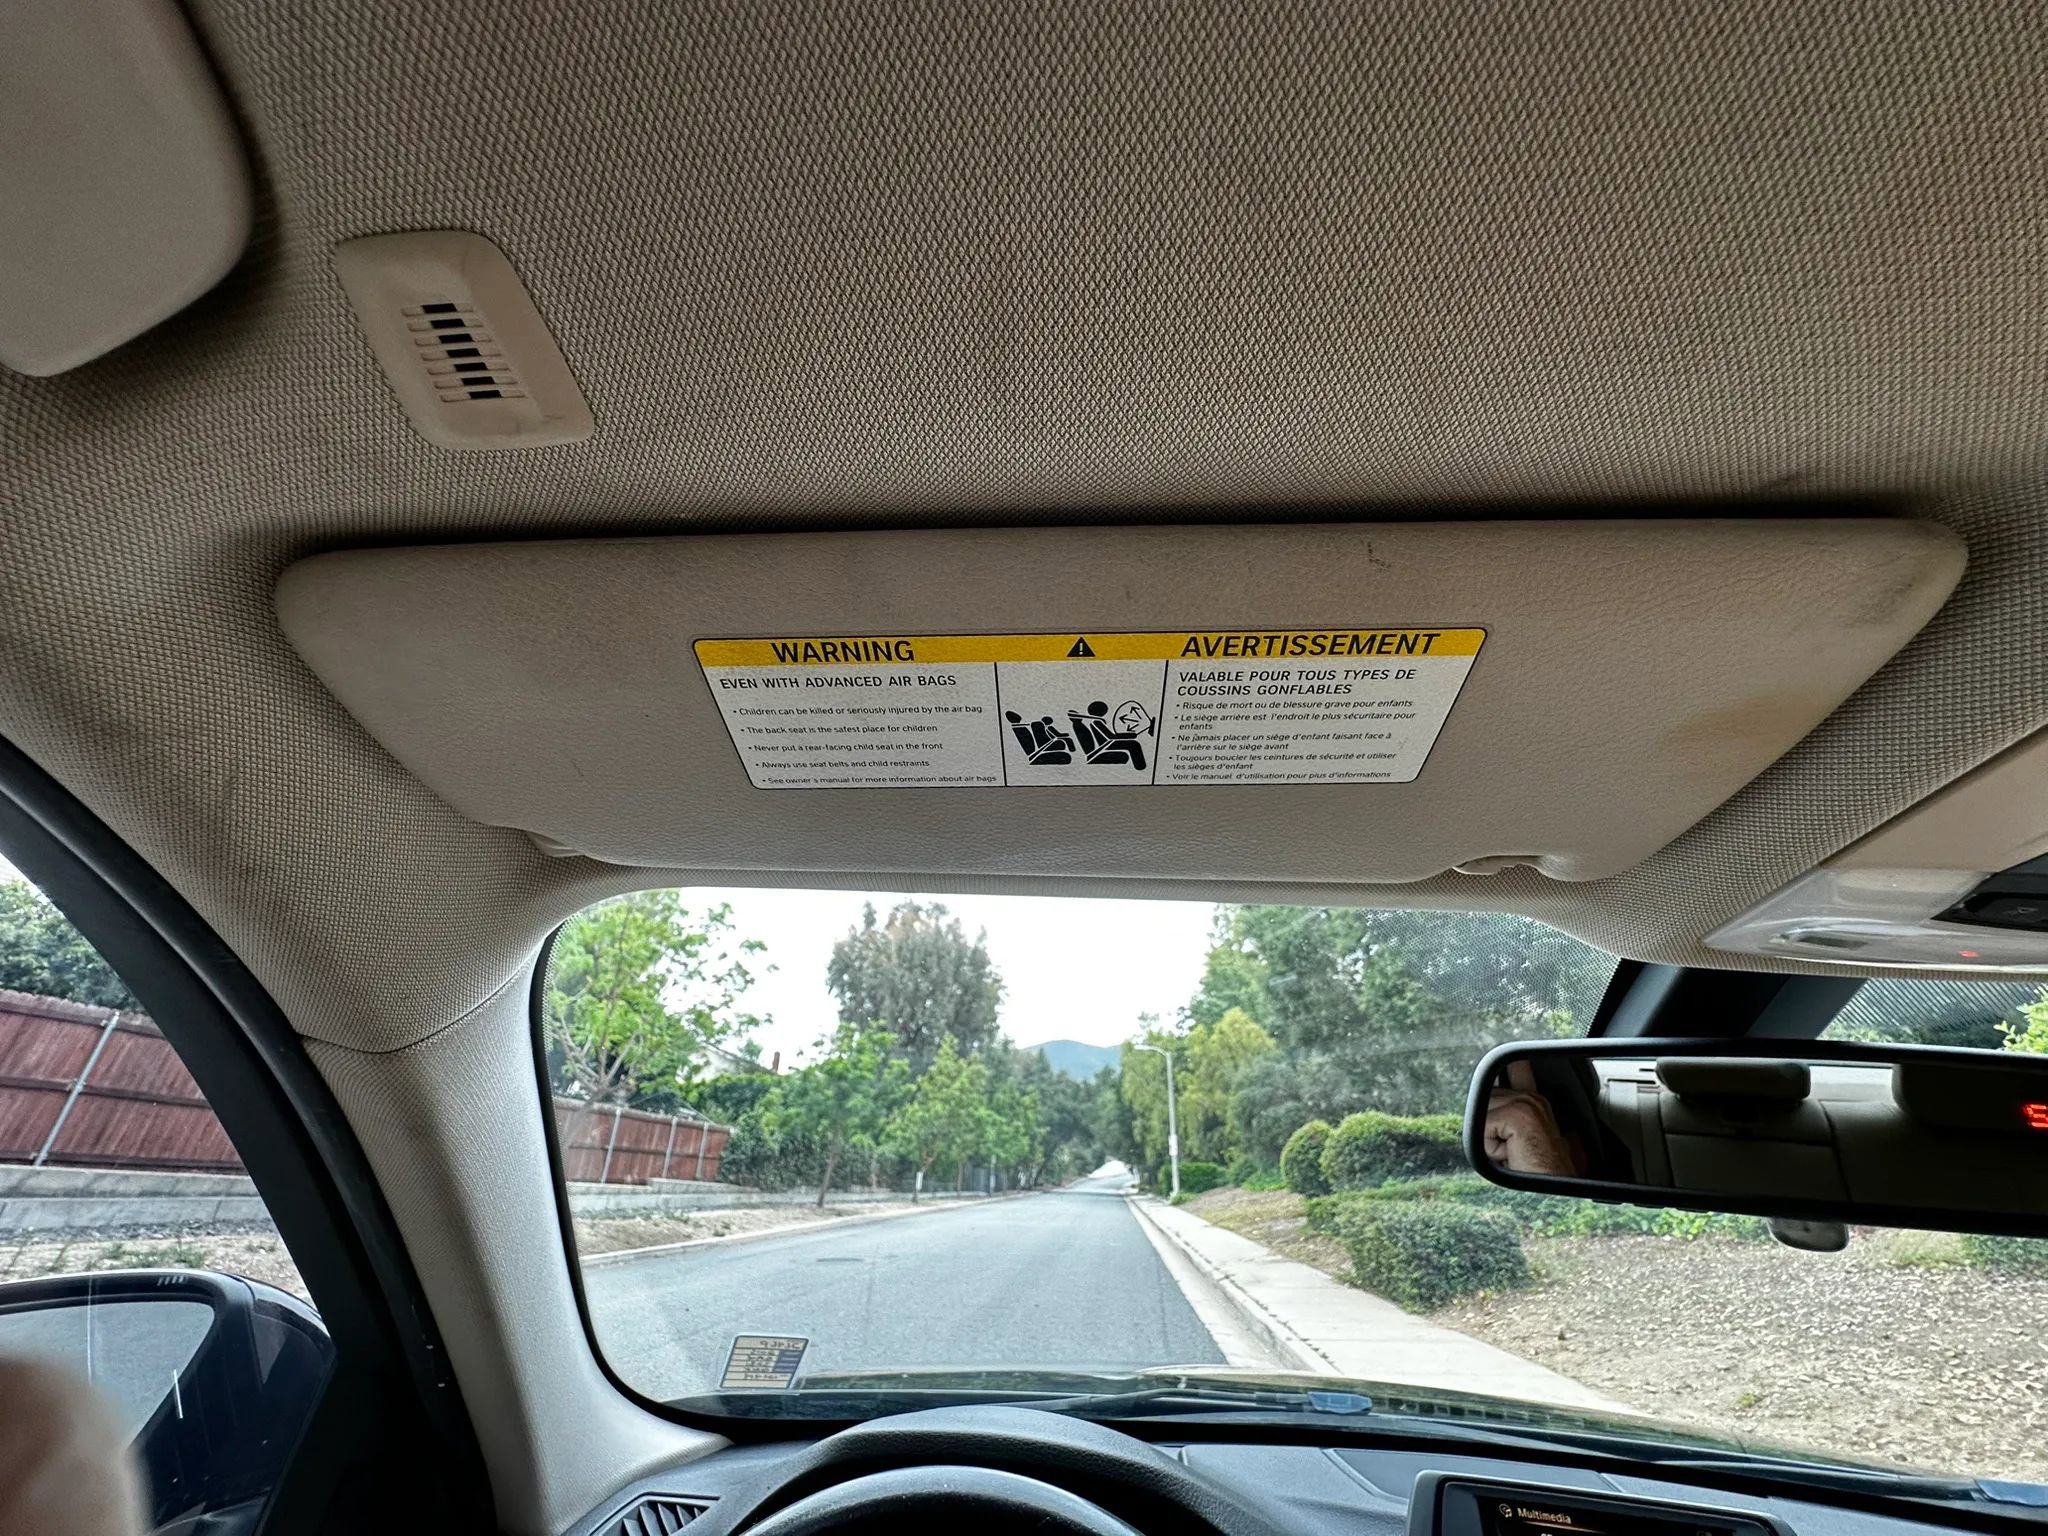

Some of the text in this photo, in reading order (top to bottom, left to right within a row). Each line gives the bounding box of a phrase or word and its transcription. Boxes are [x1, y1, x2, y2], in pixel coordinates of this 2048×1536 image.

[1181, 633, 1441, 657] AVERTISSEMENT
[770, 640, 915, 663] WARNING
[1179, 669, 1417, 682] VALABLE POUR TOUS TYPES DE
[720, 675, 957, 689] EVEN WITH ADVANCED AIR BAGS
[1177, 684, 1352, 696] COUSSINS GONFLABLES
[1182, 701, 1213, 710] Risque
[1215, 701, 1228, 709] de
[1282, 700, 1323, 708] blessure
[1324, 701, 1350, 710] grave
[1352, 701, 1376, 710] pour
[1377, 700, 1413, 708] enfants
[739, 708, 777, 716] Children
[797, 707, 808, 715] be
[810, 707, 834, 715] killed
[846, 707, 886, 715] seriously
[888, 706, 920, 714] injured
[921, 706, 932, 714] by
[965, 705, 983, 713] bag
[1193, 714, 1218, 722] siège
[1219, 713, 1250, 721] arrière
[1321, 712, 1341, 721] plus
[1343, 712, 1392, 720] sécuritaire
[1393, 712, 1416, 721] pour
[765, 726, 786, 734] back
[834, 725, 861, 733] safest
[862, 725, 886, 733] place
[902, 724, 938, 732] children
[1191, 734, 1221, 742] jamais
[1222, 734, 1250, 742] placer
[1265, 734, 1290, 742] siège
[1364, 732, 1384, 740] face
[1385, 731, 1392, 740] à
[754, 744, 779, 752] Never
[781, 744, 797, 752] put
[1238, 743, 1263, 751] siège
[1175, 754, 1213, 762] Toujours
[1263, 752, 1304, 761] ceintures
[1319, 752, 1354, 760] sécurité
[1367, 752, 1397, 760] utiliser
[1187, 763, 1215, 771] sièges
[1286, 772, 1307, 780] pour
[1308, 771, 1327, 780] plus
[1517, 1507, 1572, 1524] Multimedia
